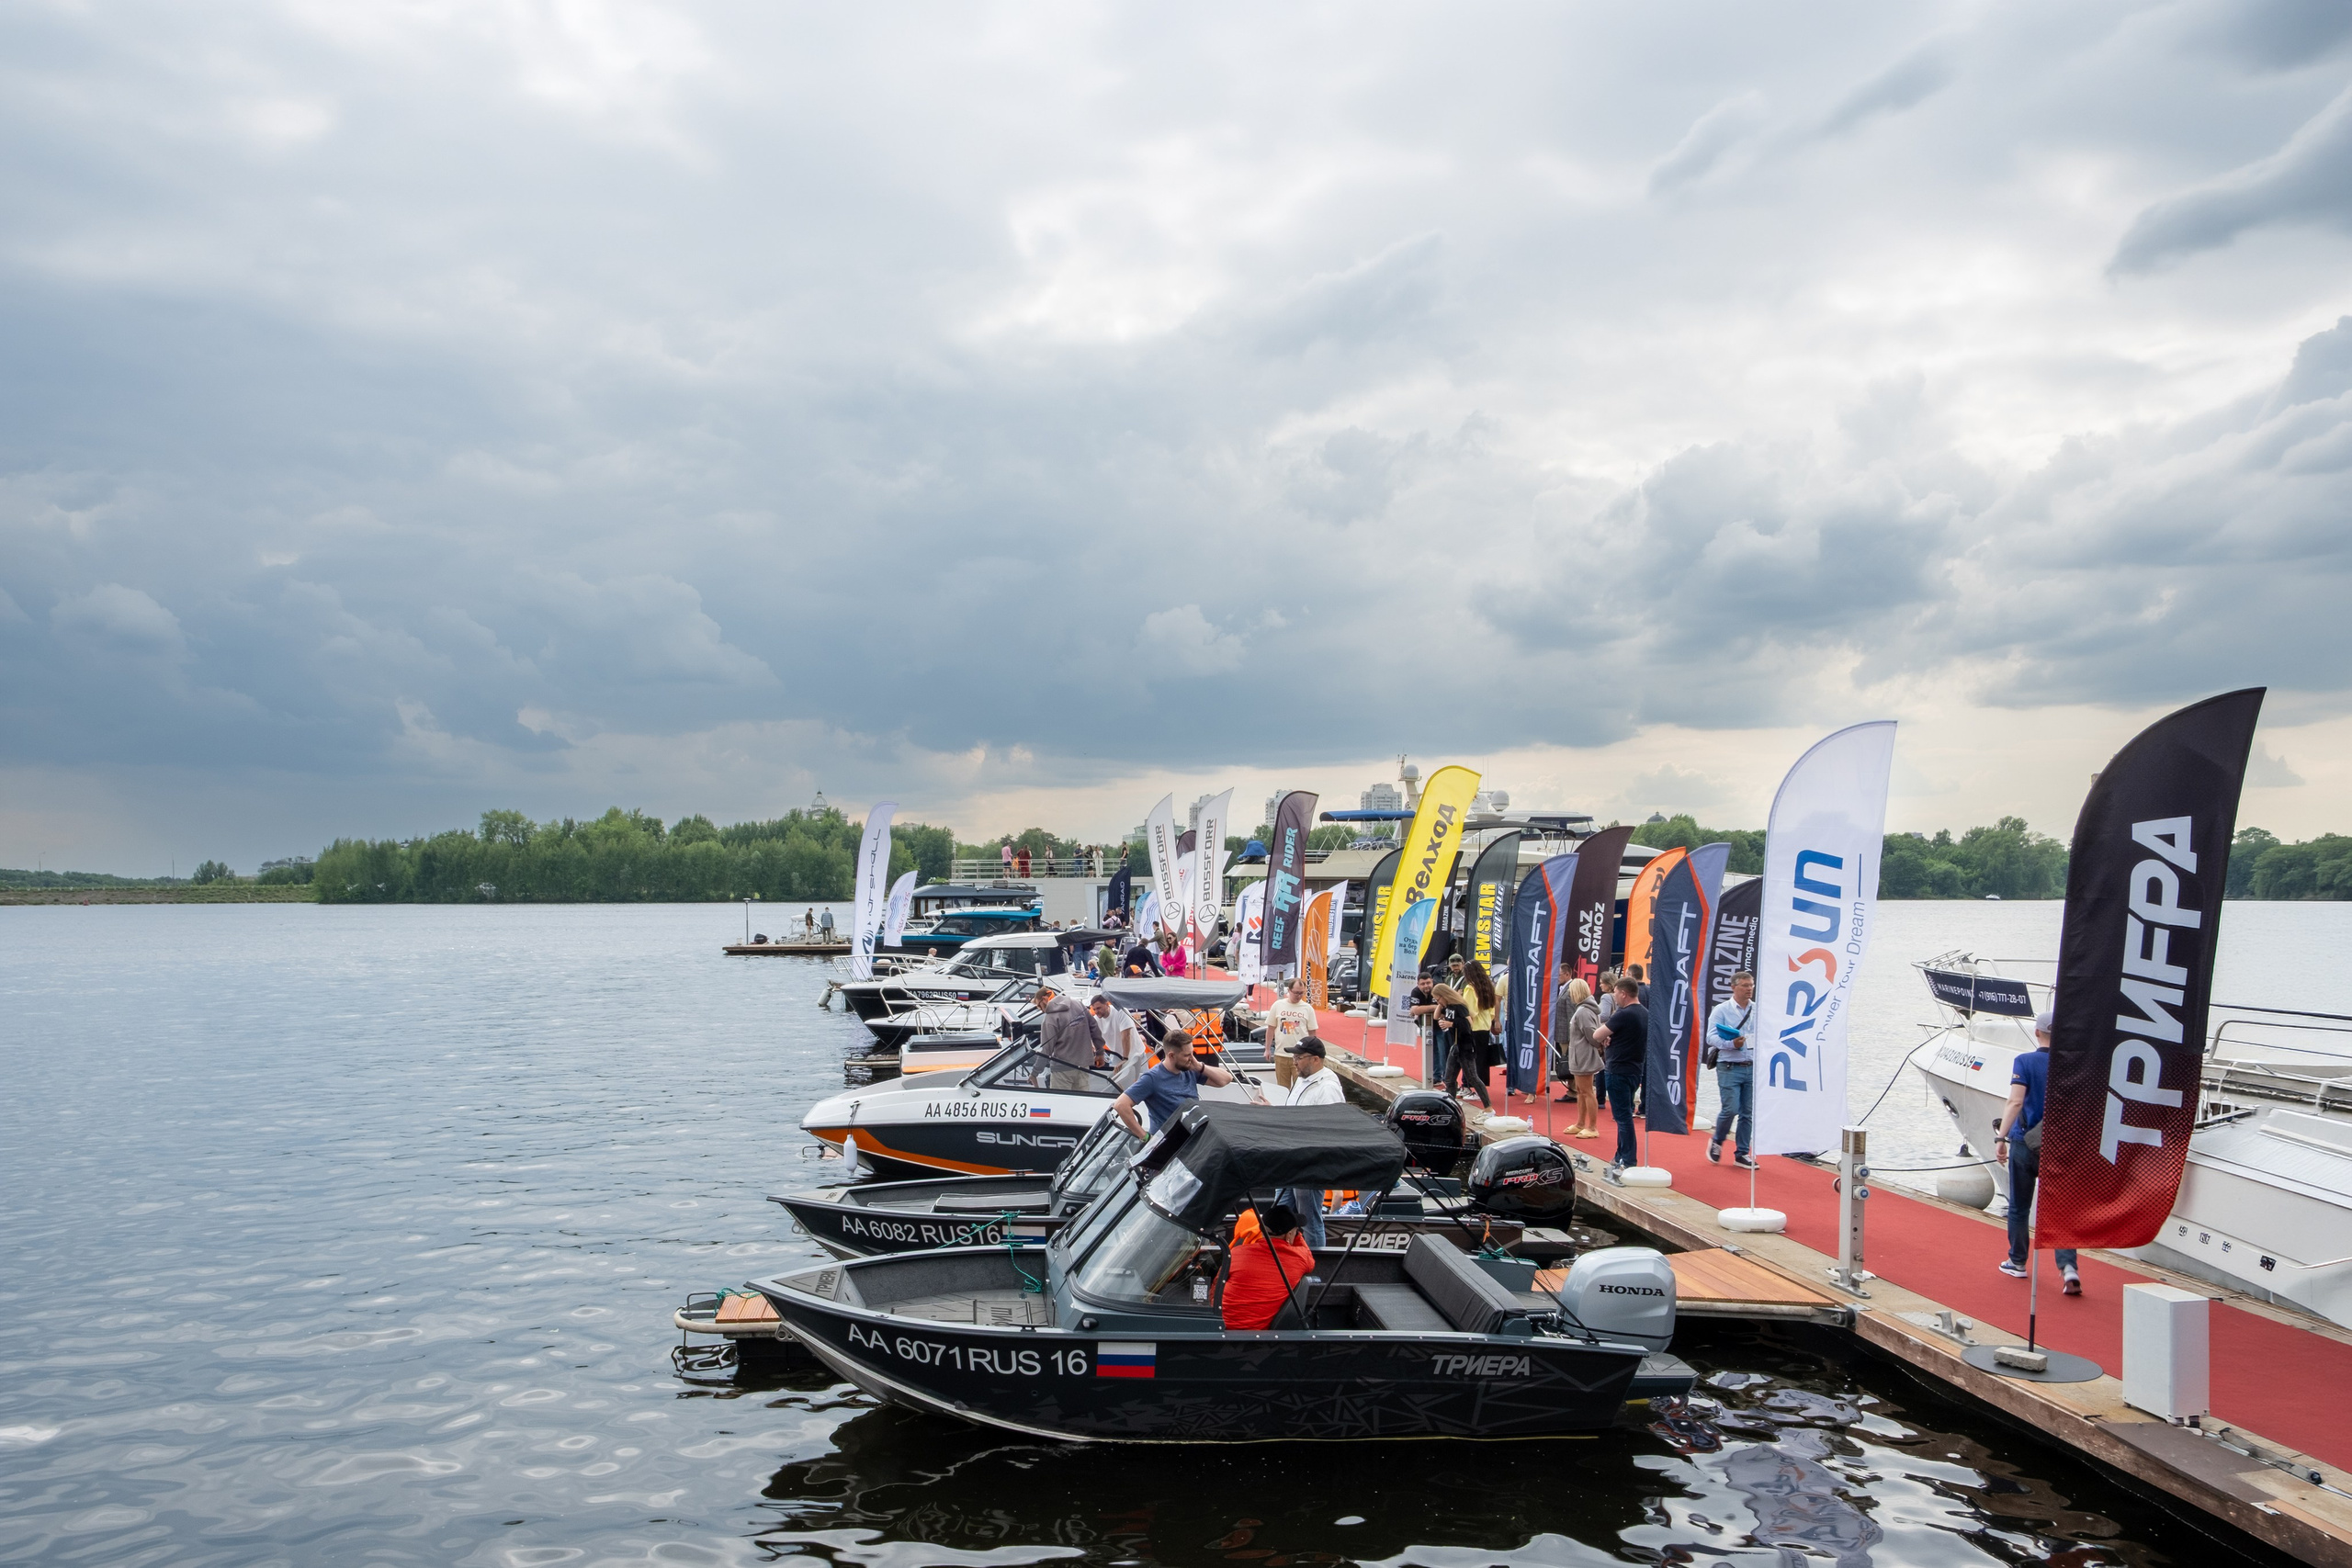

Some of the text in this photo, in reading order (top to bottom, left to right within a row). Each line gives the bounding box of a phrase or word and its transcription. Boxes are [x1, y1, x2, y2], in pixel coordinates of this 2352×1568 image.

[1156, 825, 1171, 900] BOSSFORR
[1204, 819, 1215, 901] BOSSFORR
[1272, 916, 1284, 950] REEF
[1283, 827, 1297, 868] RIDER
[1493, 884, 1505, 951] marine
[1578, 910, 1593, 952] GAZ
[1836, 959, 1856, 992] Your
[1847, 902, 1865, 955] Dream
[1520, 901, 1546, 1069] SUNCRAFT
[1712, 913, 1748, 1008] AGAZINE
[1770, 849, 1843, 1091] PARSUN
[1667, 902, 1697, 1106] SUNCRAFT
[924, 1102, 1027, 1118] AA 4856 RUS 63
[1505, 1168, 1534, 1176] MERCURY
[842, 1215, 1001, 1245] AA 6082 RUS 16
[1599, 1285, 1665, 1296] HONDA
[848, 1323, 1087, 1375] AA 6071 RUS 16
[1431, 1355, 1530, 1376] ТРИЕРА
